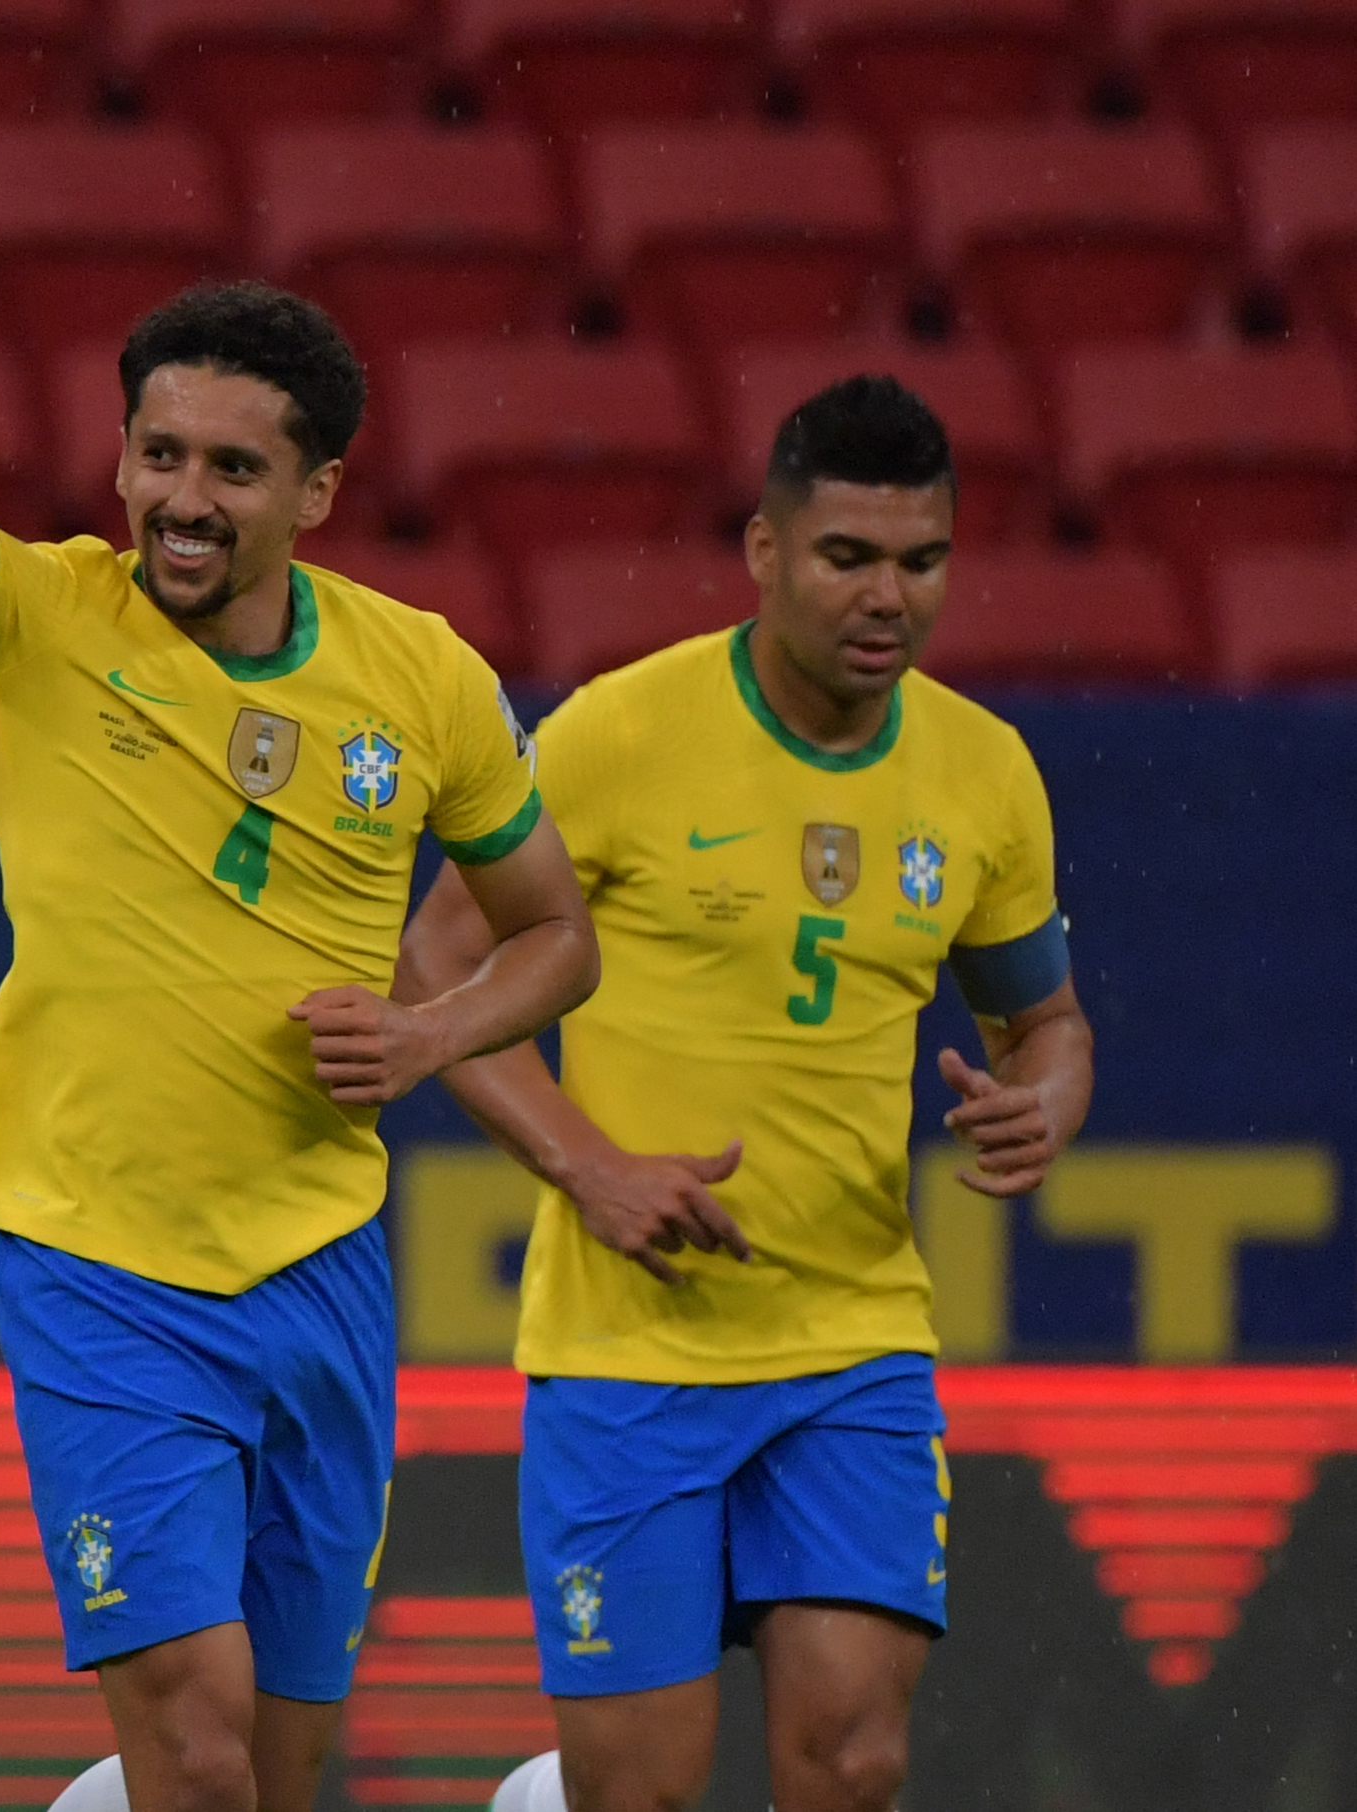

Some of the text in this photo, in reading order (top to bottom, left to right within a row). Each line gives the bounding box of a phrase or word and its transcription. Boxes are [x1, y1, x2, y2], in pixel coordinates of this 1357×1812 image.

[99, 711, 124, 726] BRASIL
[359, 763, 382, 774] CBF
[334, 815, 393, 837] BRASIL
[213, 802, 275, 904] 4
[787, 914, 846, 1026] 5
[85, 1588, 127, 1611] BRASIL
